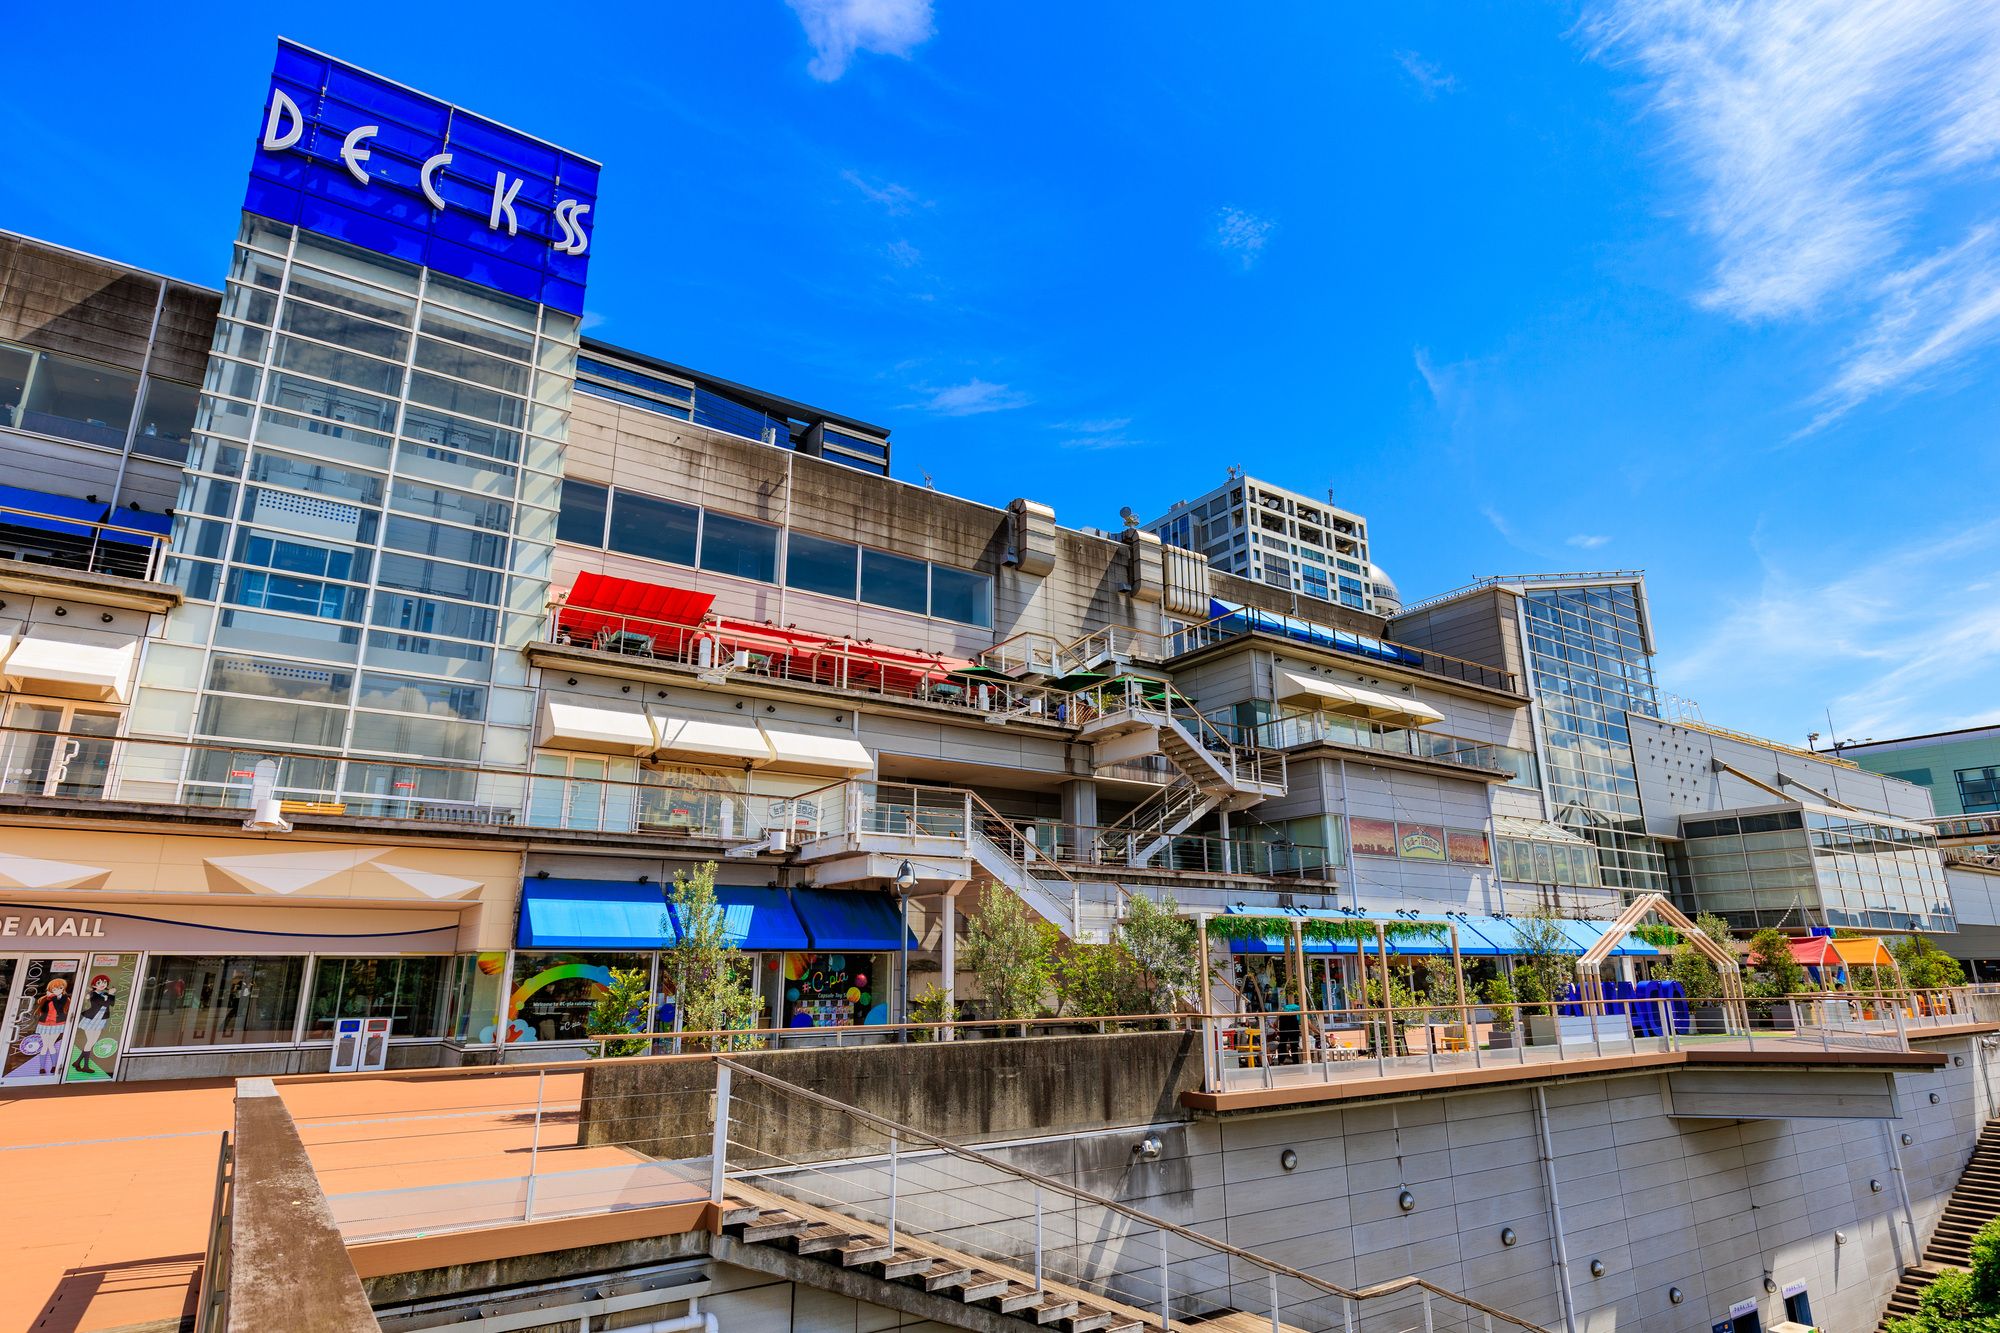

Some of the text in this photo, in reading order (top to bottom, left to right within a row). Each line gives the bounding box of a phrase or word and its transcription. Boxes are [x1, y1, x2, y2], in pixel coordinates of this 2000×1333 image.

[0, 917, 105, 937] E MALL
[802, 971, 848, 993] #C-pla
[108, 995, 128, 1033] VERDE
